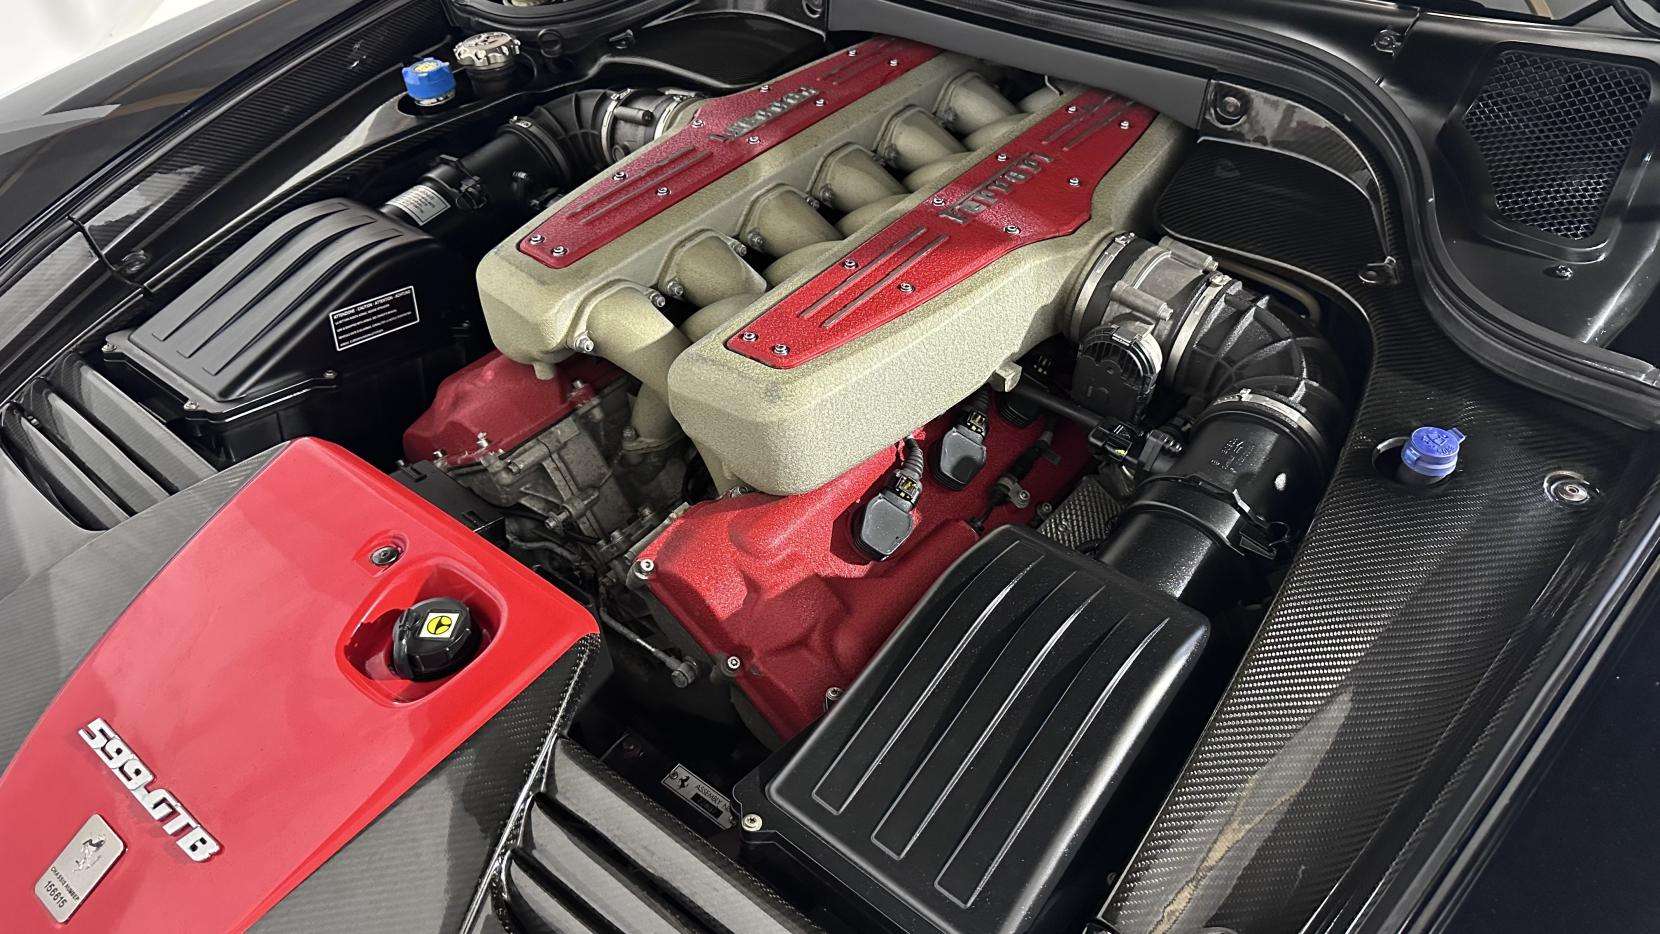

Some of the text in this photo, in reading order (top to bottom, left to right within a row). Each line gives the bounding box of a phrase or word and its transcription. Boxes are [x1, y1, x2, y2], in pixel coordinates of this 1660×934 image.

[78, 717, 221, 862] 599 GTB
[43, 880, 68, 909] 156615
[50, 866, 81, 902] CHASSIS NUMBER
